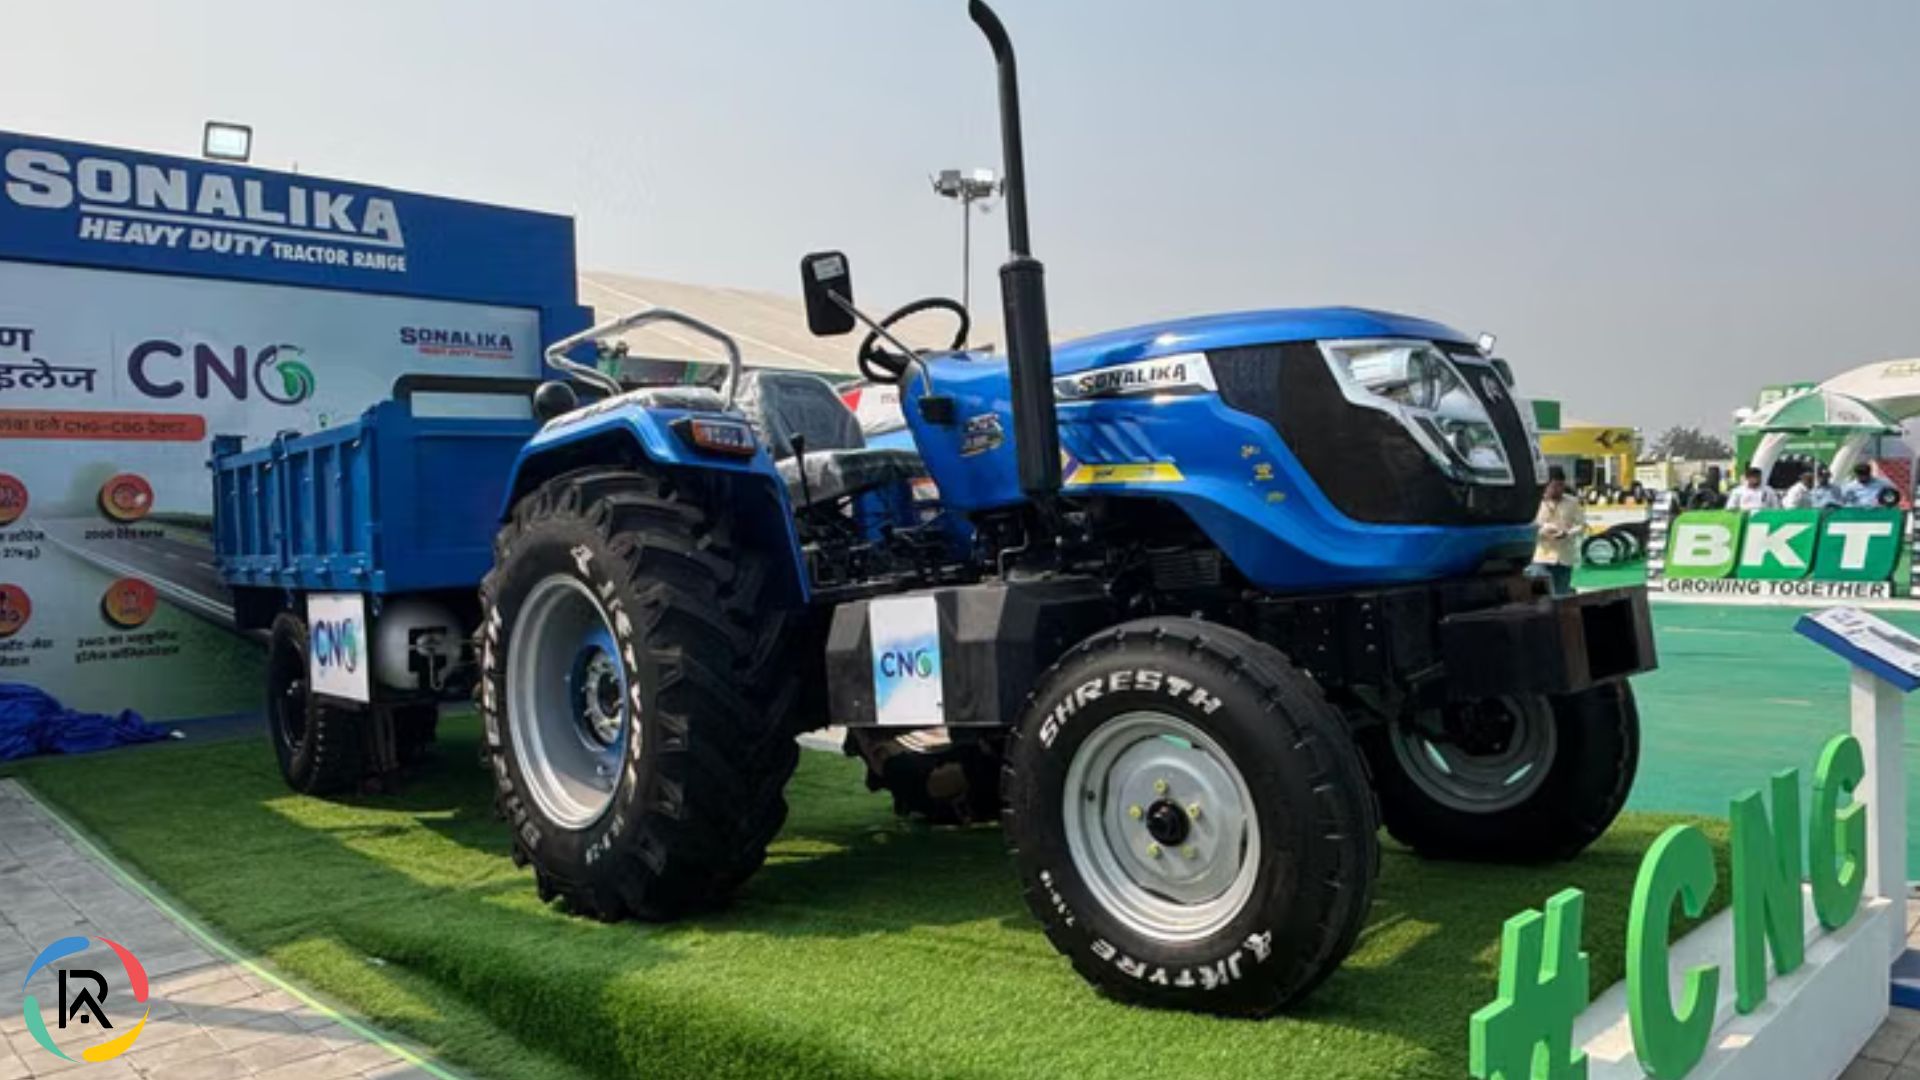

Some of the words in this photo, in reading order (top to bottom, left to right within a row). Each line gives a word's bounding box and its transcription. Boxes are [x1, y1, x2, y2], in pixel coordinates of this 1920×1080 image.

[4, 147, 405, 248] SONALIKA
[79, 216, 186, 249] HEAVY
[189, 229, 269, 257] DUTY
[273, 241, 348, 266] TRACTOR
[352, 252, 407, 273] RANGE
[400, 326, 514, 352] SONALIKA
[1079, 363, 1188, 390] SONALIKA
[1671, 522, 1893, 570] BKT
[1667, 577, 1761, 596] GROWING
[1768, 578, 1886, 598] TOGETHER
[1039, 668, 1223, 750] SHRESTH
[1469, 734, 1868, 1080] #CNG
